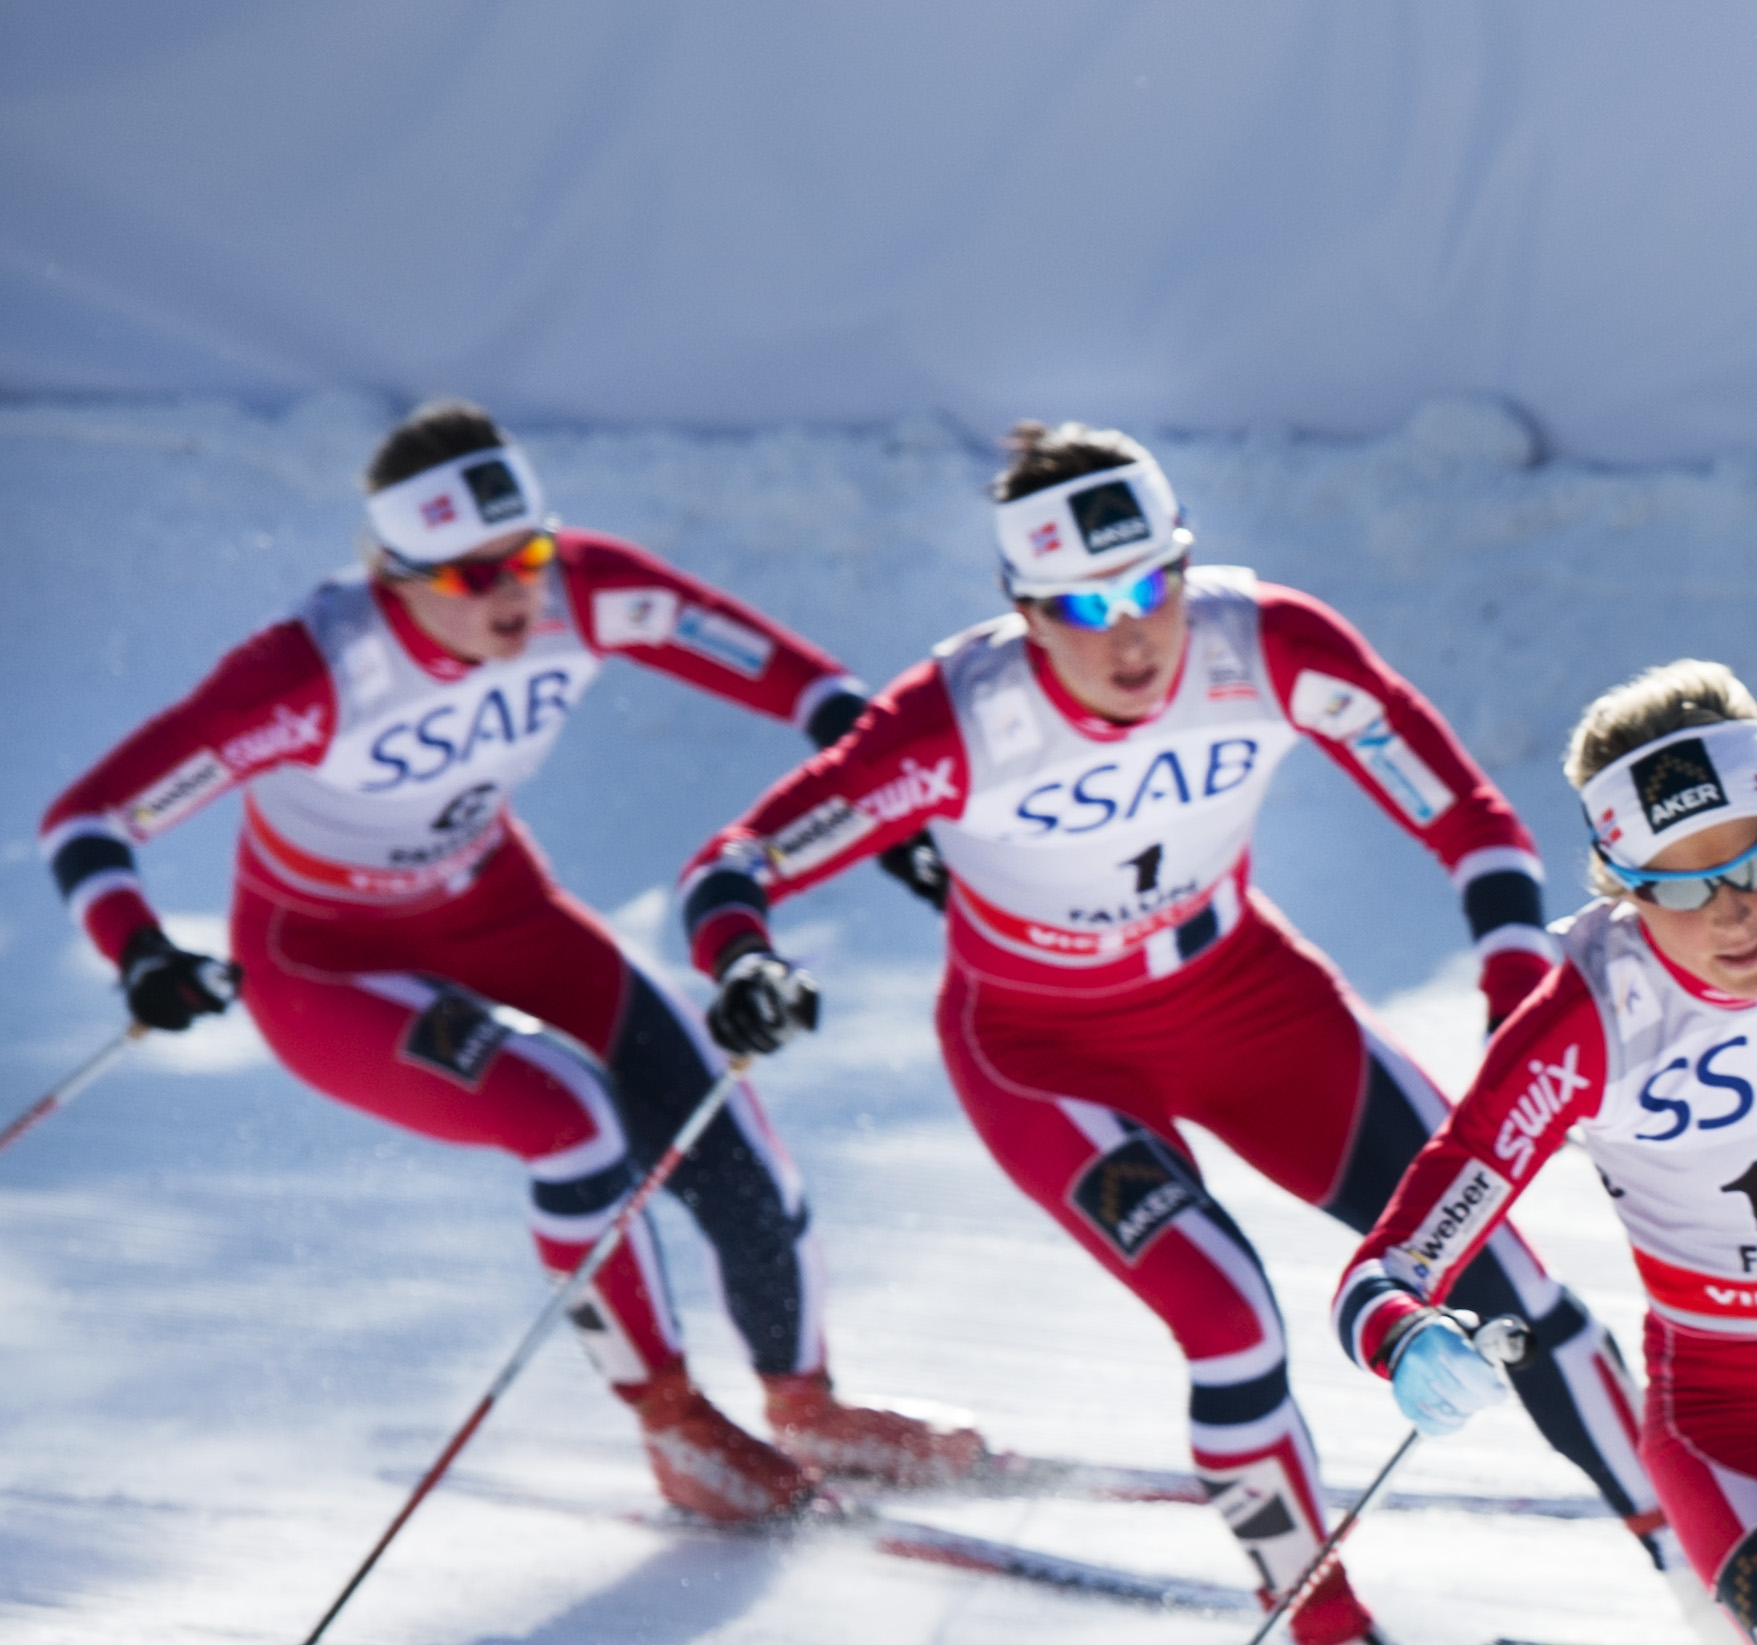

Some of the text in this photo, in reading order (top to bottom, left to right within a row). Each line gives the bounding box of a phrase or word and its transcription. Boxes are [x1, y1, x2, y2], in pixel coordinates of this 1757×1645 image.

[362, 669, 569, 792] SSAB
[1000, 738, 1258, 841] SSAB
[1651, 782, 1720, 825] AKER
[1117, 843, 1163, 895] 1
[1420, 1170, 1491, 1261] weber
